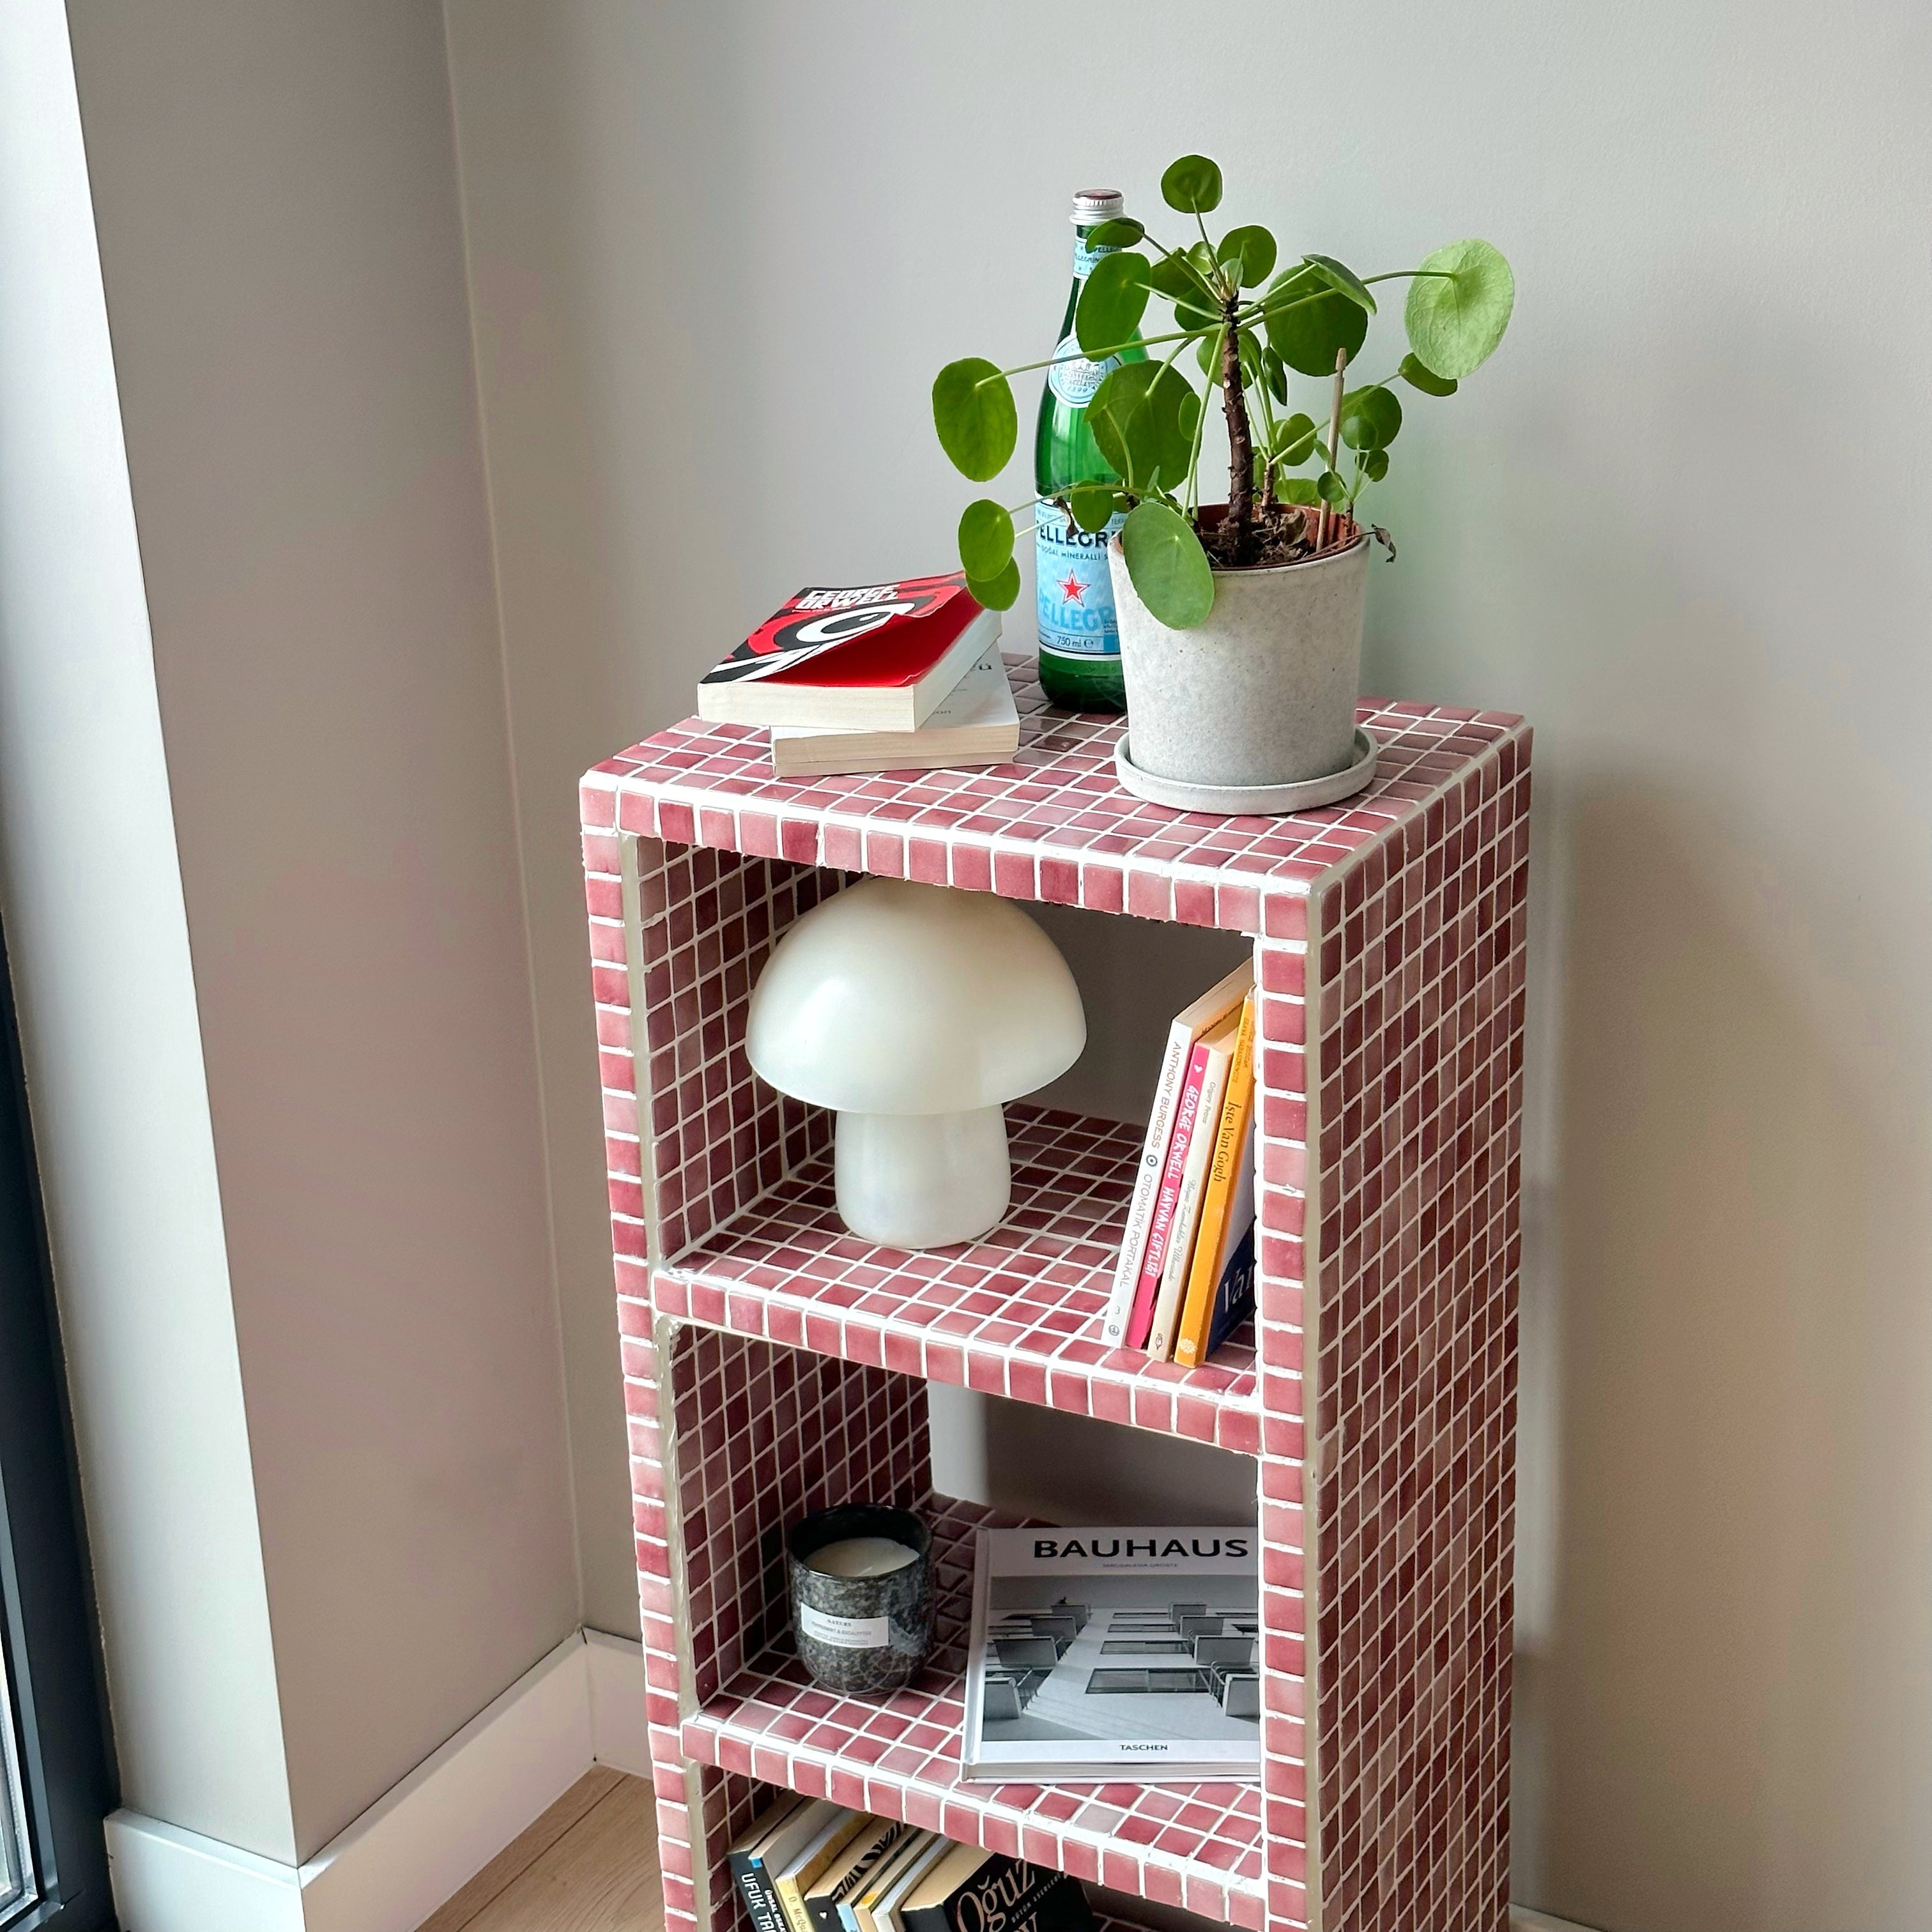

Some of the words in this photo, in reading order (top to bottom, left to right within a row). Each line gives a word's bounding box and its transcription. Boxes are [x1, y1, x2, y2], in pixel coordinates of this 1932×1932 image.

[795, 592, 898, 609] ORWELL
[804, 584, 900, 600] GEORGE
[1057, 635, 1071, 647] 750
[1164, 1041, 1182, 1096] ANTHONY
[1151, 1096, 1170, 1149] BURGESS
[1179, 1085, 1199, 1132] GEORGE
[1167, 1131, 1188, 1180] ORWELL
[1221, 1127, 1235, 1149] Van
[1213, 1151, 1229, 1182] Gogh
[1133, 1173, 1153, 1230] OTOMATİK
[1154, 1186, 1176, 1232] HAYVAN
[1119, 1230, 1140, 1287] PORTAKAL
[1034, 1539, 1248, 1558] BAUHAUS
[741, 1873, 767, 1910] UFUK
[758, 1911, 778, 1932] TA
